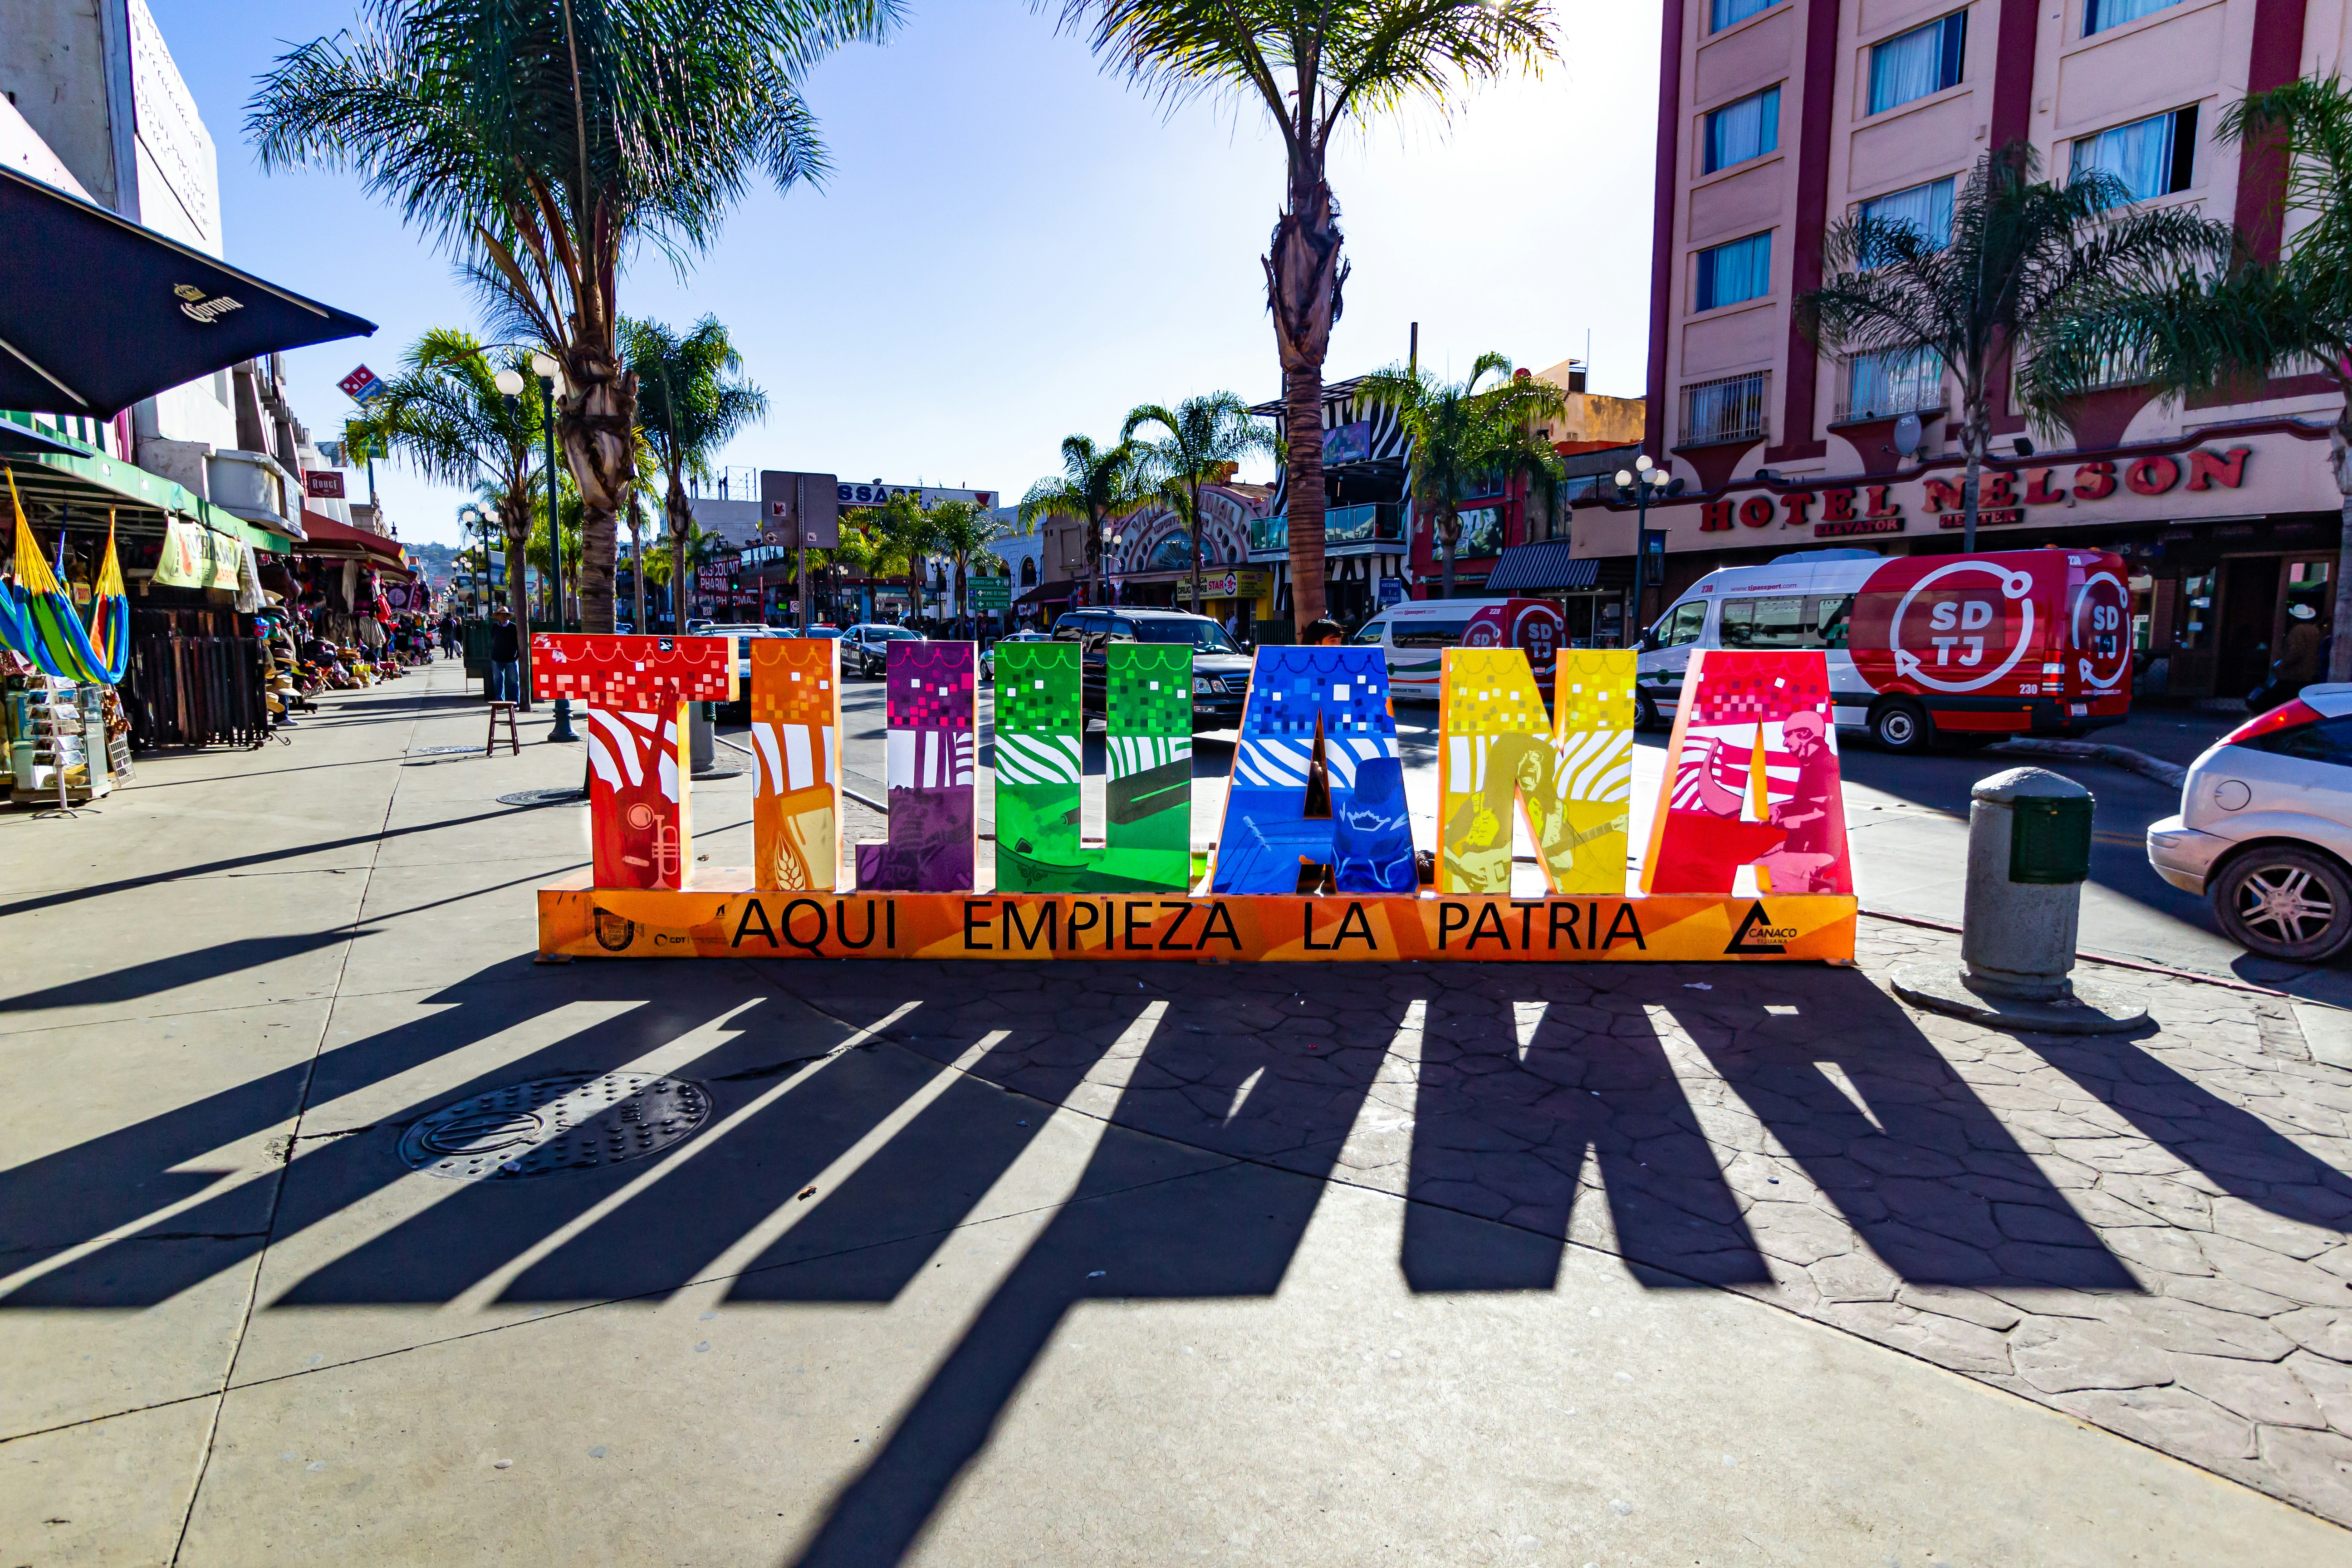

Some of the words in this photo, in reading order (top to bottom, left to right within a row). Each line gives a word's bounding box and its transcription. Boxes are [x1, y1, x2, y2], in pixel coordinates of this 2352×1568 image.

[181, 296, 244, 323] Corona
[313, 479, 338, 490] ROUGE
[1699, 485, 1899, 531] HOTEL
[1921, 449, 2252, 512] NELSON
[1940, 510, 2017, 526] HETER
[1816, 519, 1898, 534] ELEVATOR
[701, 578, 728, 591] PHARM
[1185, 577, 1207, 585] FACIA
[1208, 580, 1224, 590] STAR
[1701, 584, 1713, 593] 230
[1731, 583, 1797, 592] www.tjpassport.com
[1929, 601, 1993, 631] SD
[2093, 605, 2119, 630] SD
[1528, 623, 1552, 639] SD
[1473, 633, 1490, 646] SD
[1530, 642, 1551, 658] TJ
[1932, 637, 1984, 666] TJ
[2019, 684, 2038, 694] 230
[532, 632, 1858, 897] TIJUANA
[731, 898, 895, 956] AQUI
[965, 899, 1242, 951] EMPIEZA
[1304, 902, 1378, 951] LA
[1439, 902, 1647, 951] PATRIA
[1749, 928, 1797, 938] CANACO
